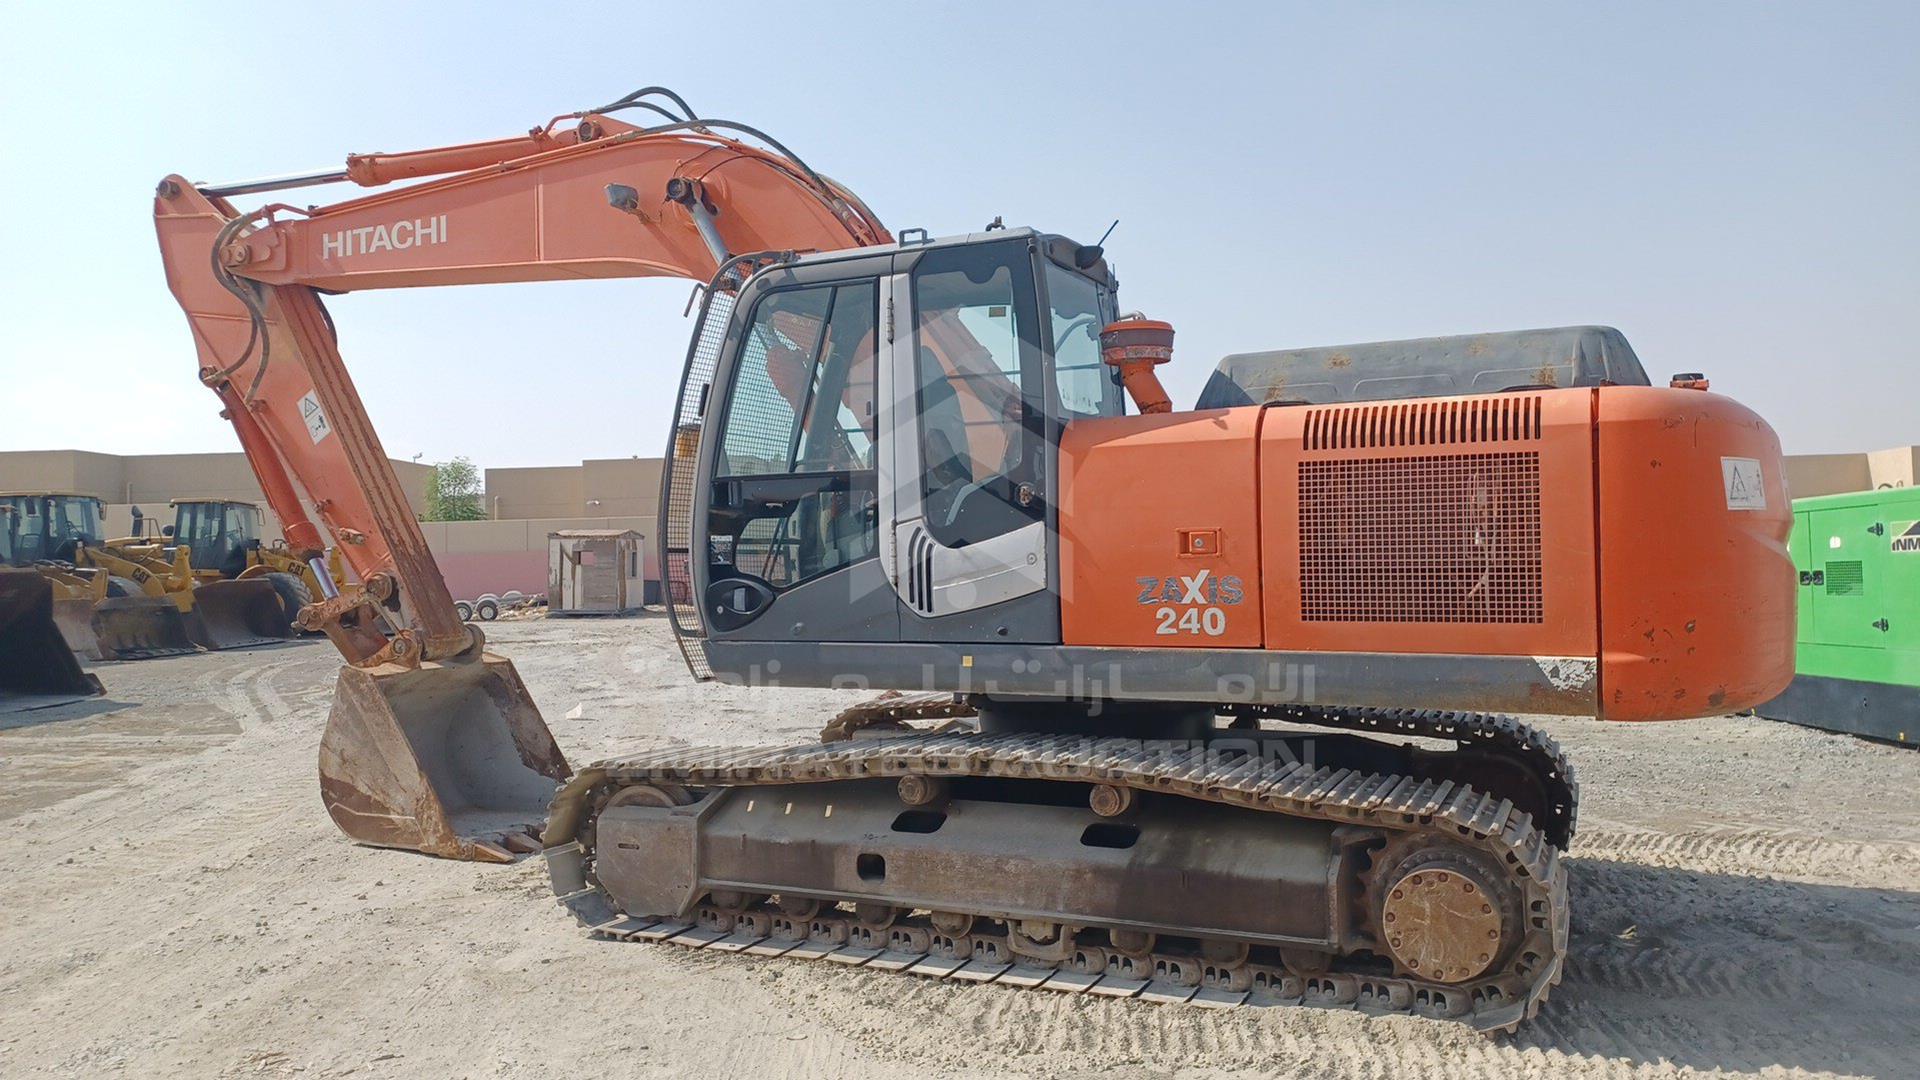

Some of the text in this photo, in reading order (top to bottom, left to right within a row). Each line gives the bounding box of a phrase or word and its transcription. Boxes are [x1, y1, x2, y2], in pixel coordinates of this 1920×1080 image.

[322, 214, 447, 259] HITACHI
[132, 567, 149, 584] CAT
[288, 562, 306, 577] CAT
[1136, 569, 1244, 605] ZAXIS
[1155, 607, 1226, 636] 240
